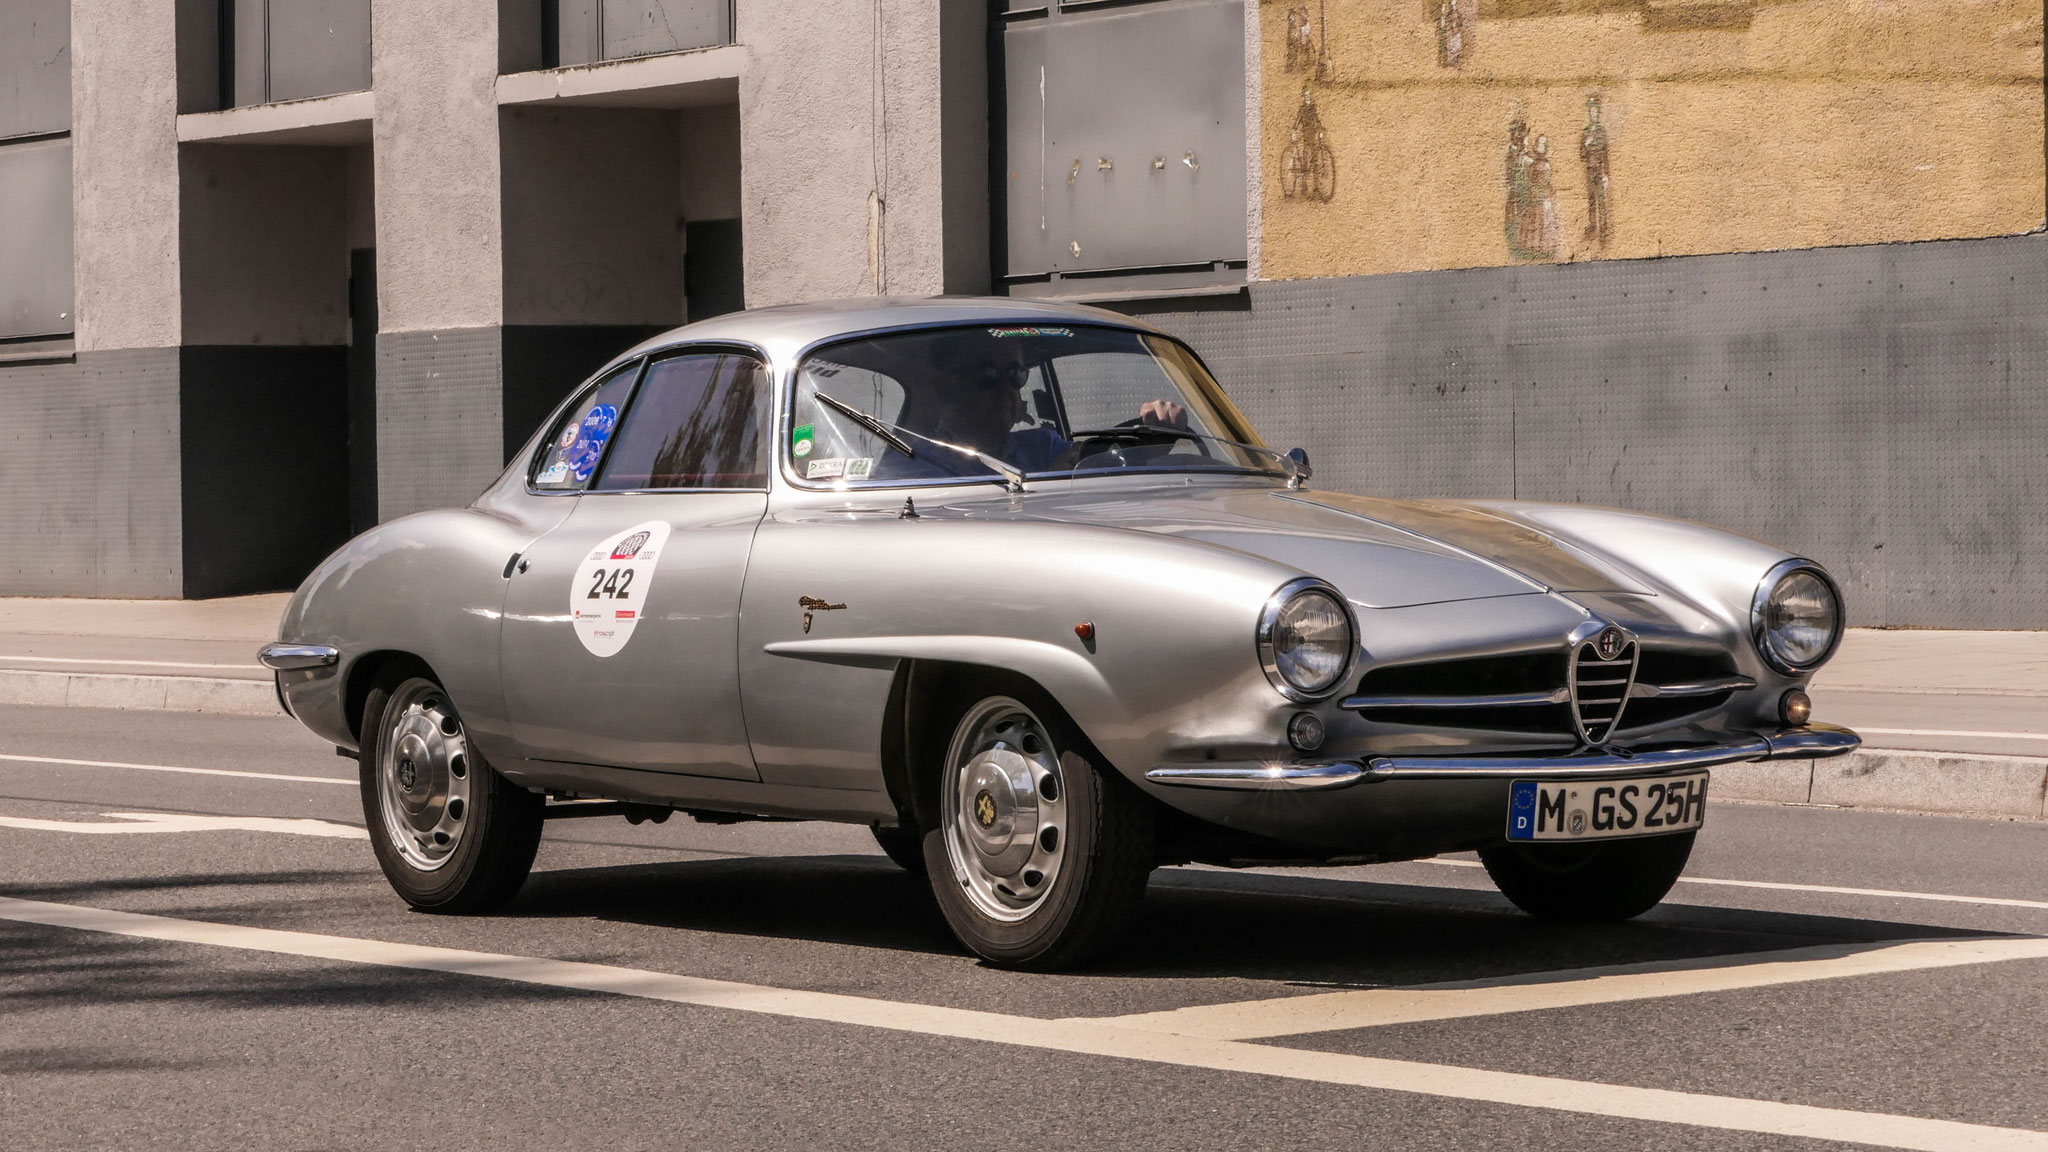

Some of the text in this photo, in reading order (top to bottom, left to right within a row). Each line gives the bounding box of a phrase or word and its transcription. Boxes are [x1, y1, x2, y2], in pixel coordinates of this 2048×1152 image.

[587, 568, 635, 599] 242
[1537, 778, 1706, 833] M GS 25H
[1517, 816, 1527, 829] D
